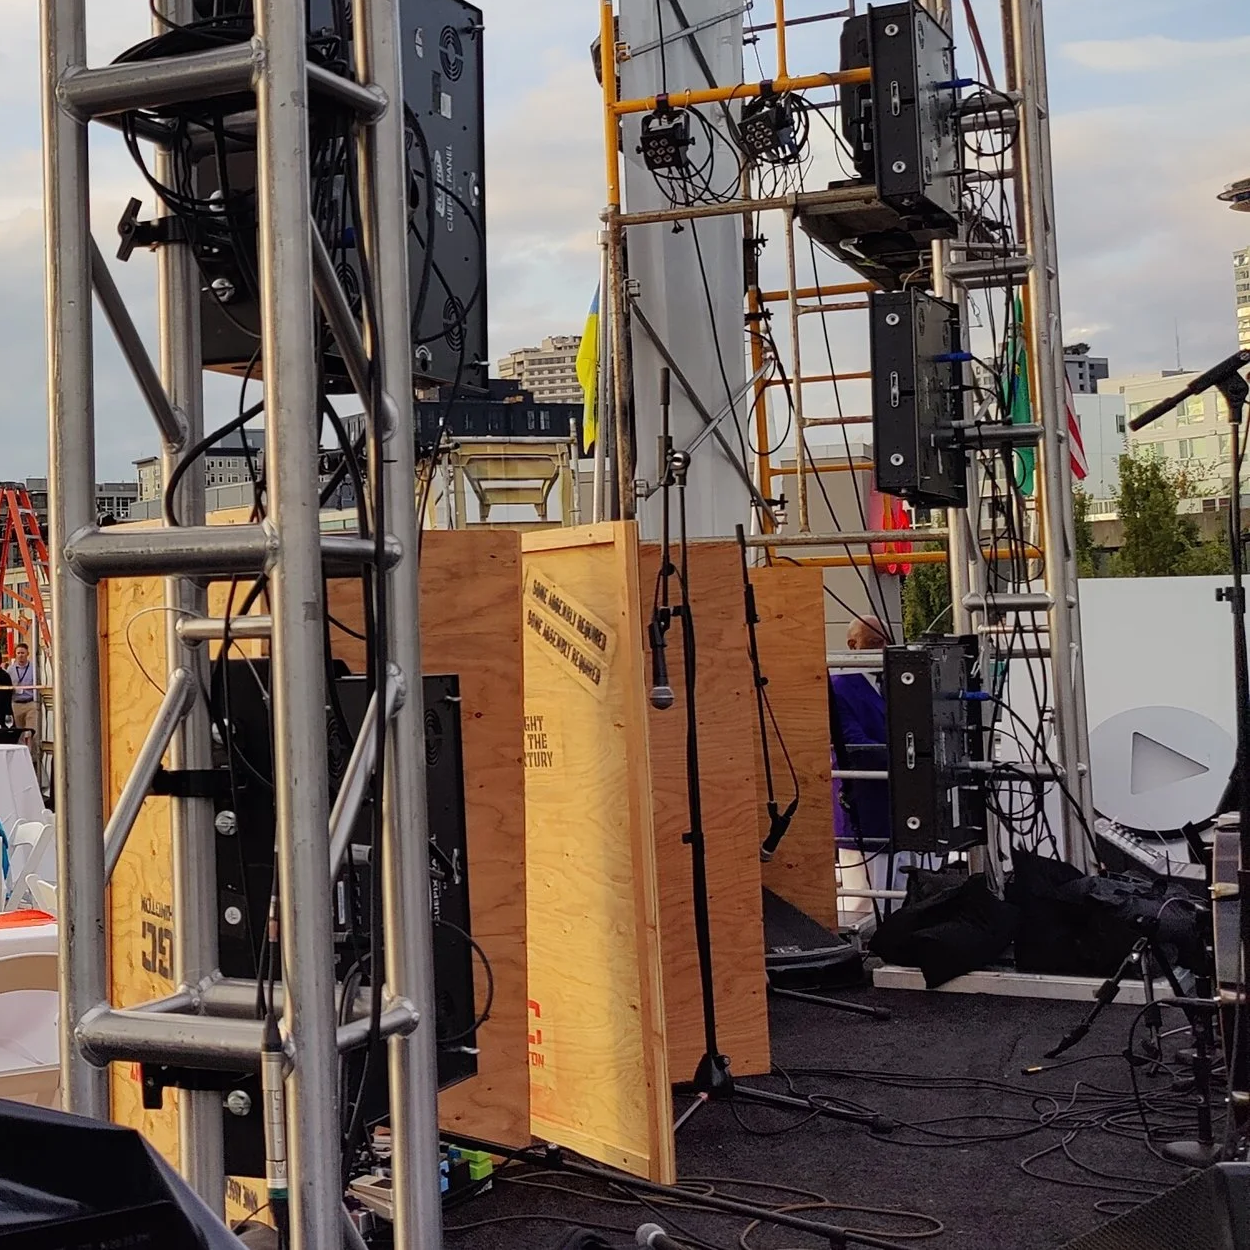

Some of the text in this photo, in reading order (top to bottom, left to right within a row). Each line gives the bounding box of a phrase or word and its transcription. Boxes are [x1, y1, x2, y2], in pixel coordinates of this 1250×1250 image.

[576, 614, 607, 651] REQUIRED
[570, 647, 601, 686] REQUIRED
[527, 733, 548, 750] THE
